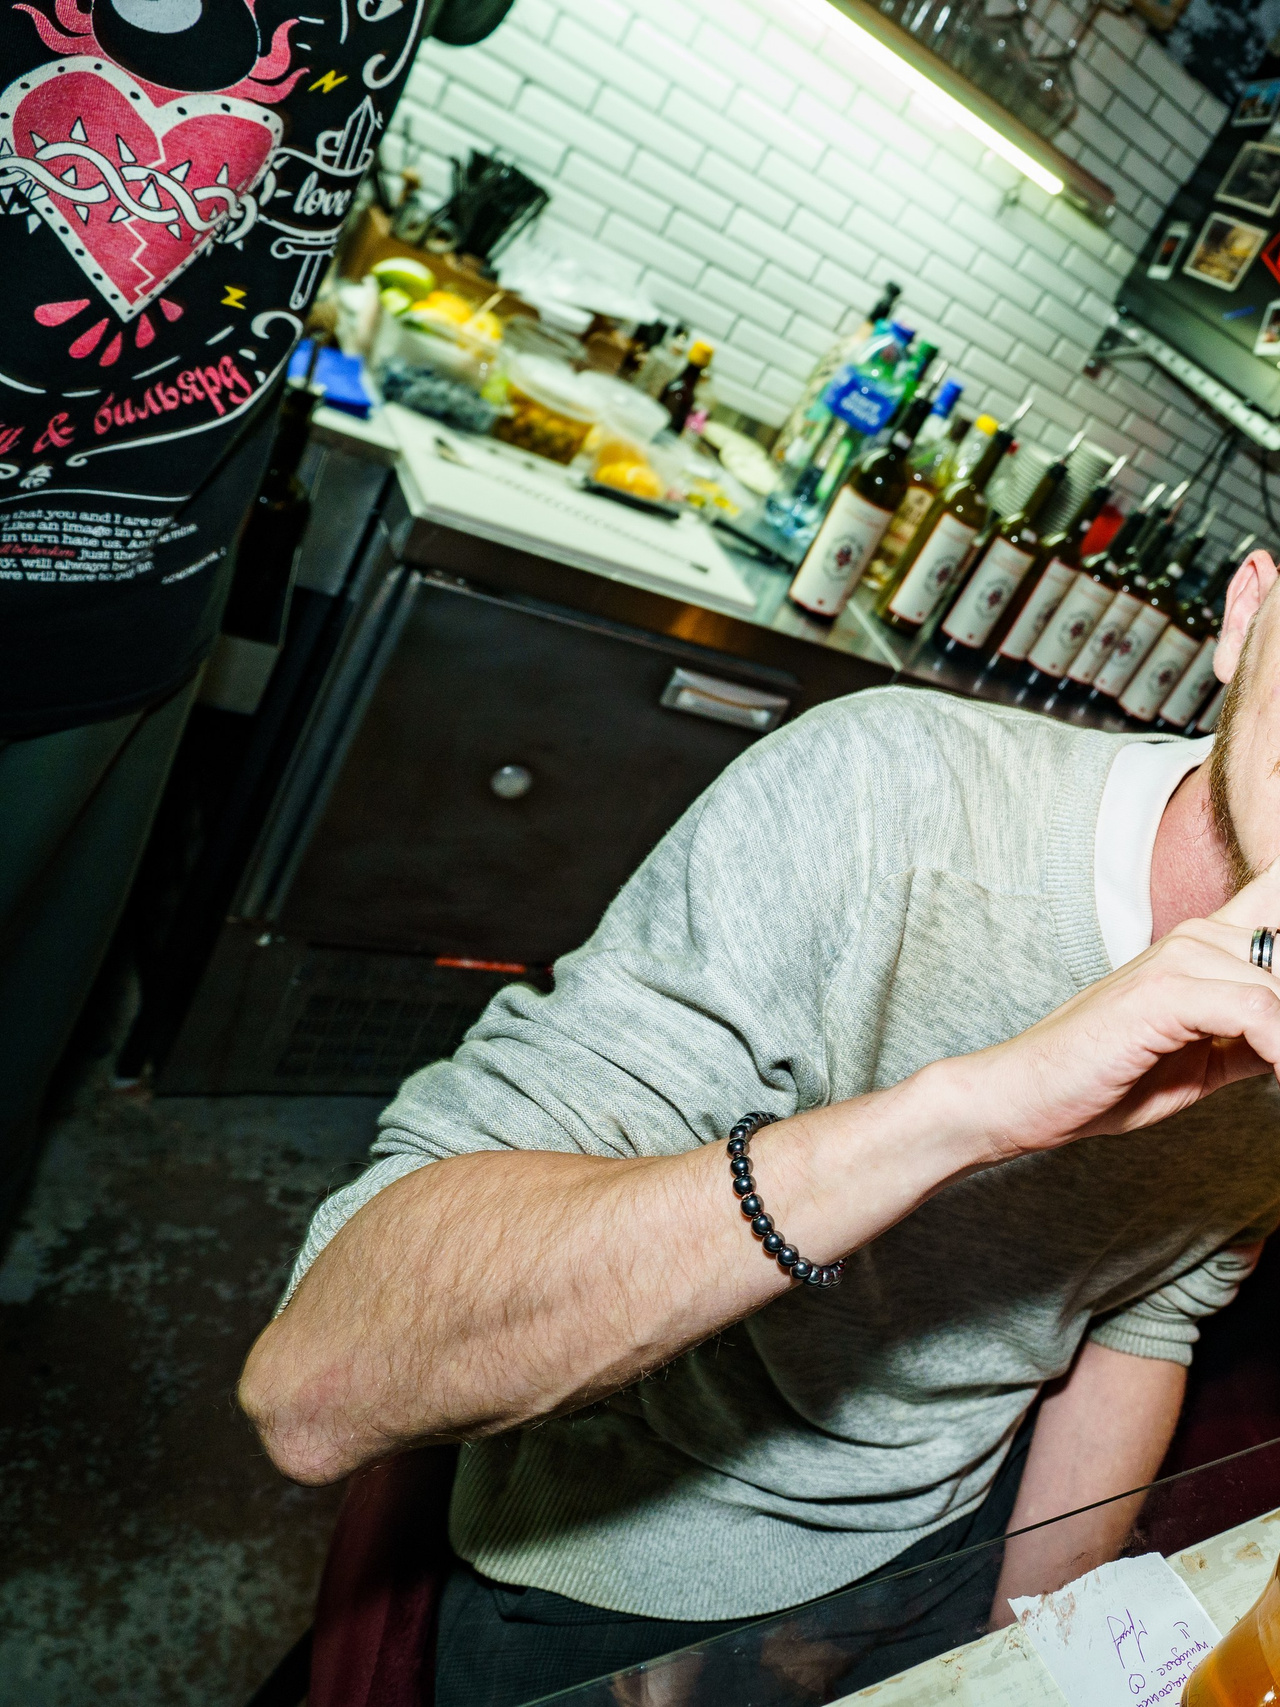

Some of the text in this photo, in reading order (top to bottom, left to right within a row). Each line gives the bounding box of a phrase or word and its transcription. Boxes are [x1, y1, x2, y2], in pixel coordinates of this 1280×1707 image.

[94, 355, 252, 435] бильярд
[44, 511, 77, 522] you
[79, 511, 112, 524] and
[114, 513, 122, 525] I
[123, 515, 152, 527] are
[37, 521, 60, 531] an
[62, 522, 113, 536] image
[114, 526, 131, 538] in
[132, 528, 145, 539] a
[20, 533, 60, 544] turn
[61, 535, 100, 547] hate
[77, 549, 111, 560] just
[19, 557, 53, 569] will
[54, 559, 111, 573] always
[24, 570, 57, 581] will
[58, 571, 97, 582] have
